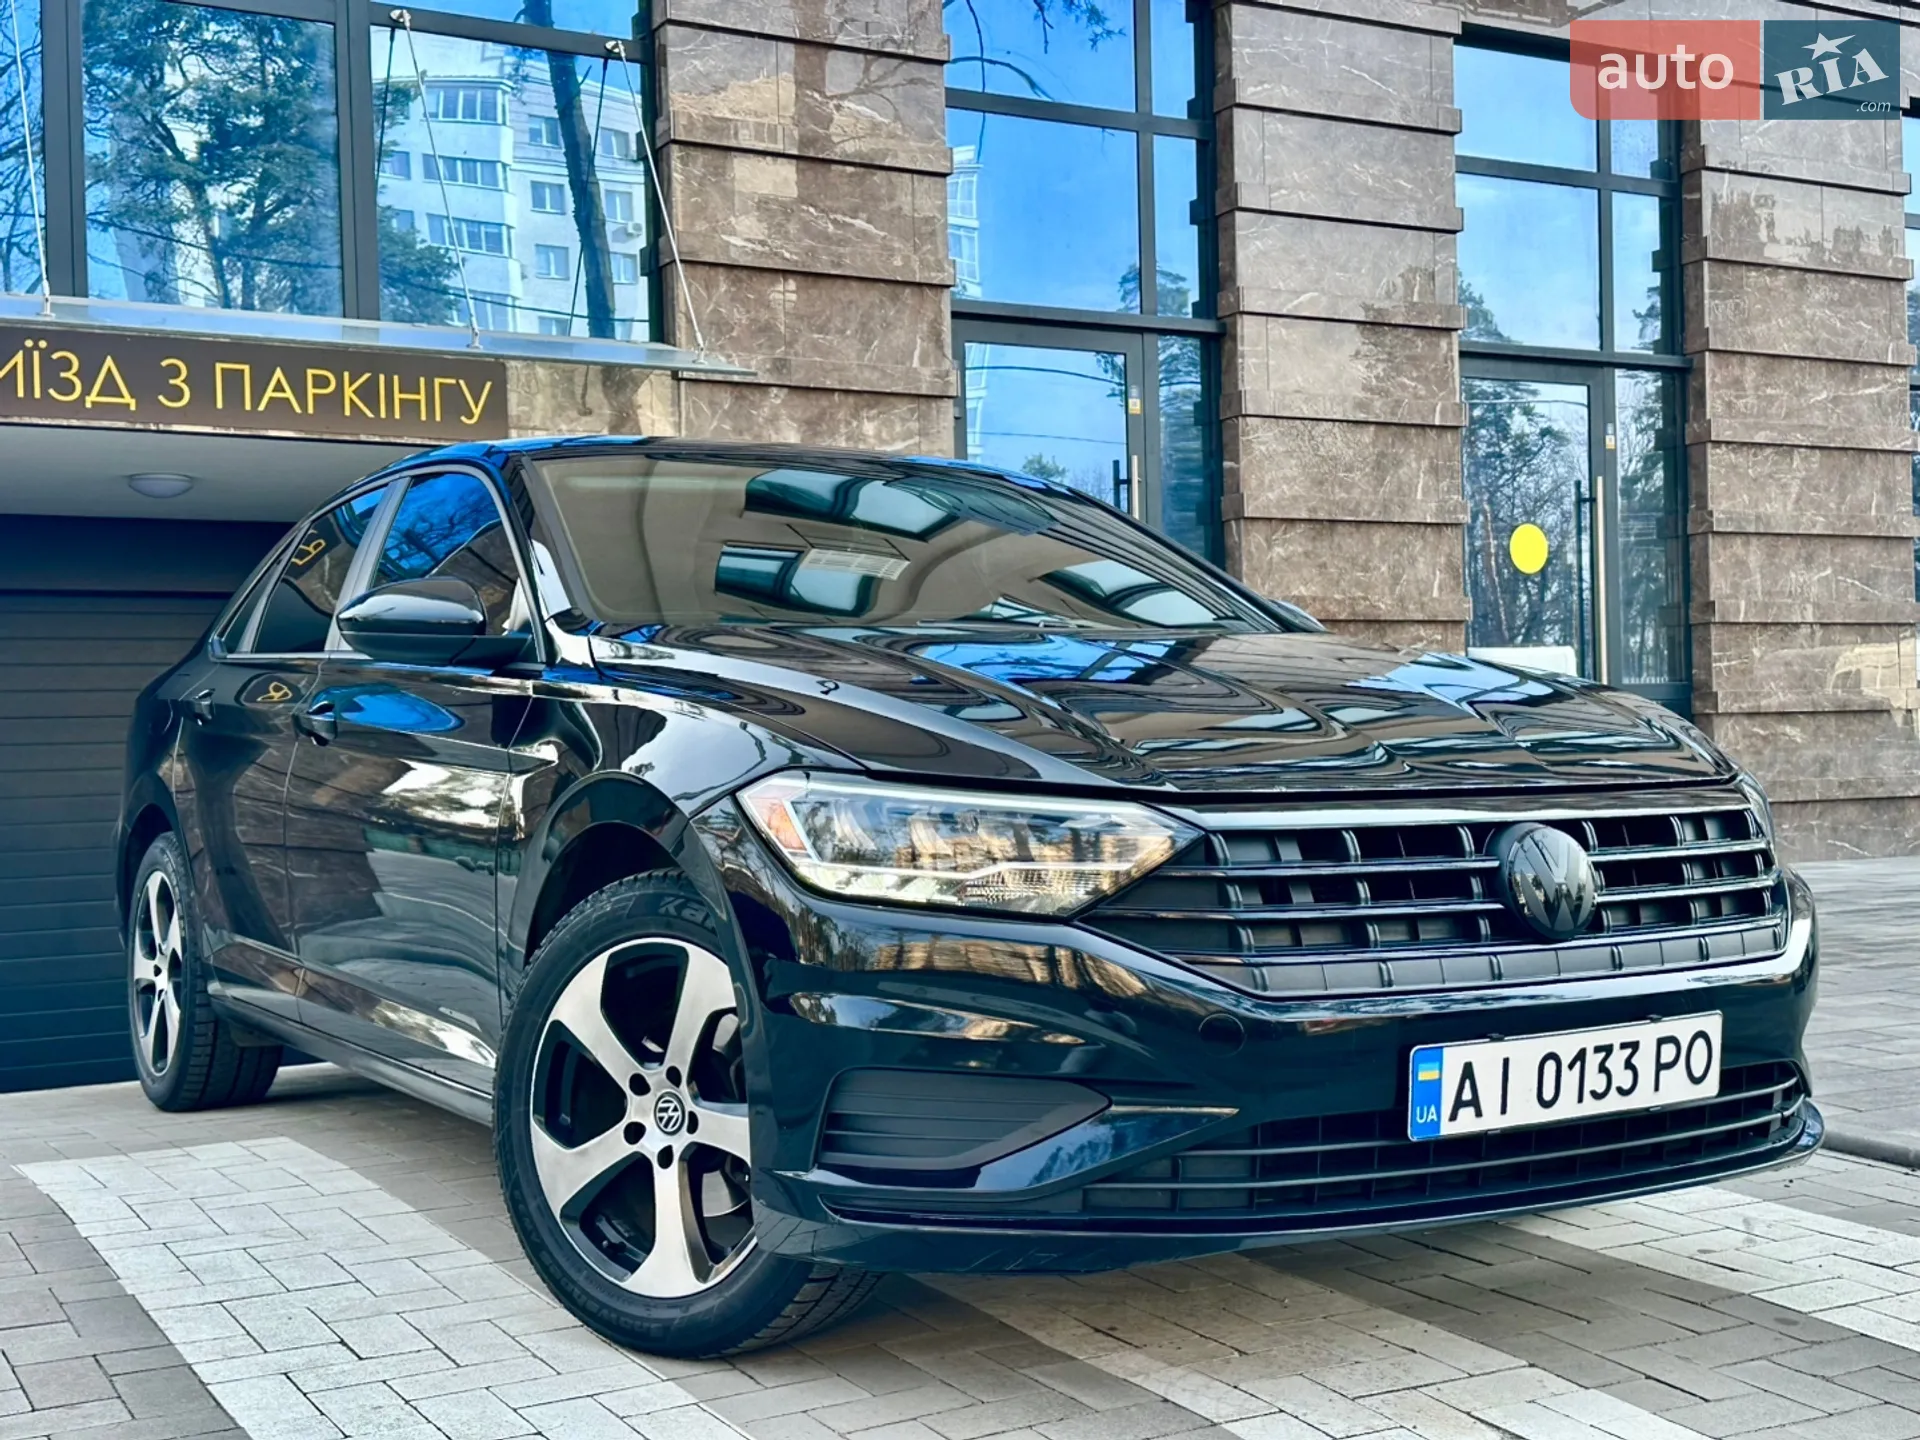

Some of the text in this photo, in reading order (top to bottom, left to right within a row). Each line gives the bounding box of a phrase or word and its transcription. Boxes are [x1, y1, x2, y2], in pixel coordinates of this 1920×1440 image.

[157, 357, 191, 409] З
[214, 361, 493, 426] ПАРКІНГУ
[1448, 1030, 1713, 1122] AI 0133 PO
[1416, 1103, 1438, 1124] UA
